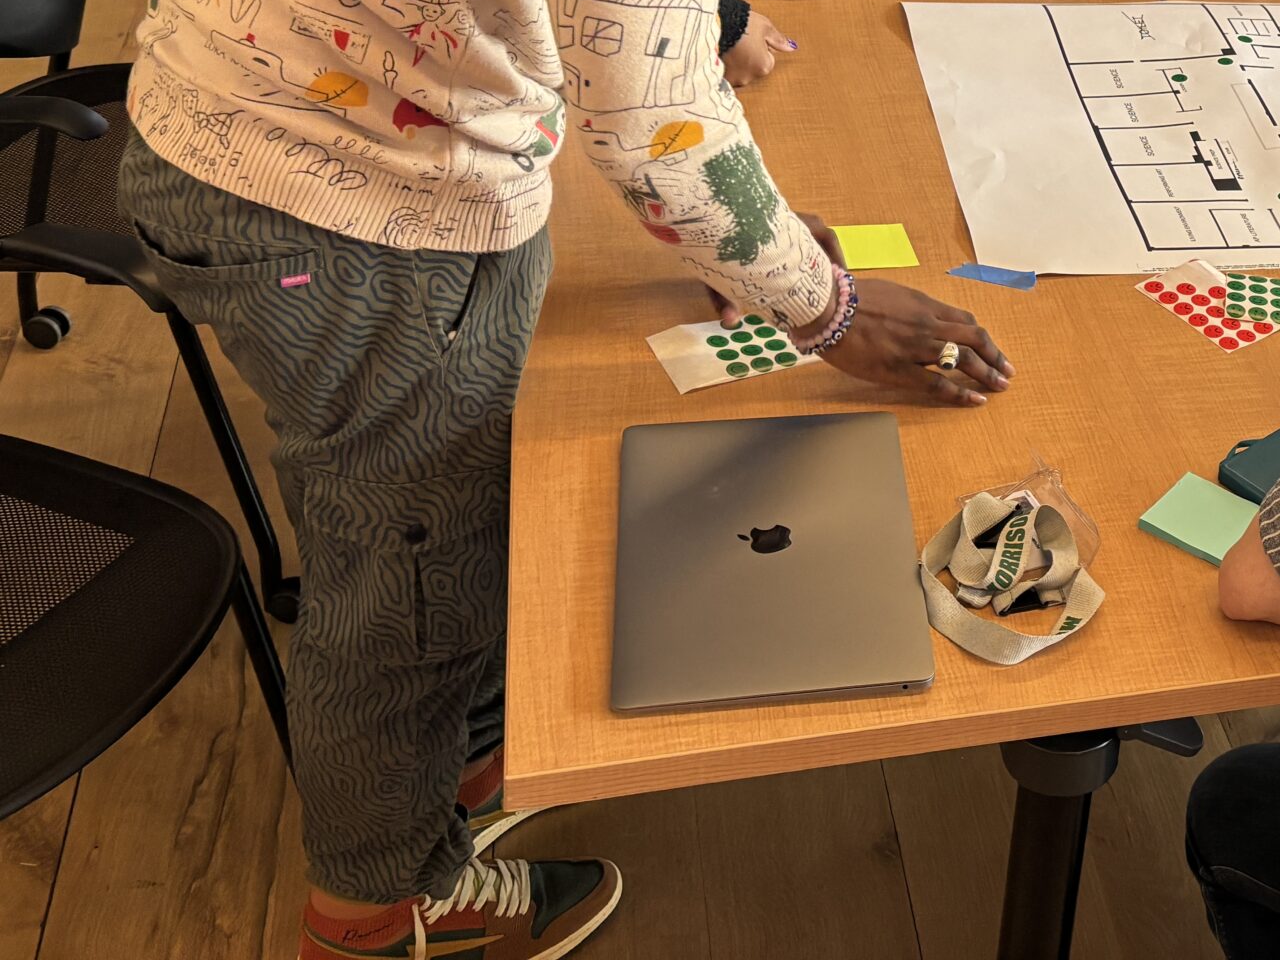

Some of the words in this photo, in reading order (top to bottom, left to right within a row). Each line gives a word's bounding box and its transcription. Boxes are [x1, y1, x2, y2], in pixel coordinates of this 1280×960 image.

[1109, 68, 1124, 89] SCIENCE
[1123, 102, 1139, 123] SCIENCE
[1139, 135, 1154, 157] SCIENCE
[1240, 213, 1257, 237] LITERATURE
